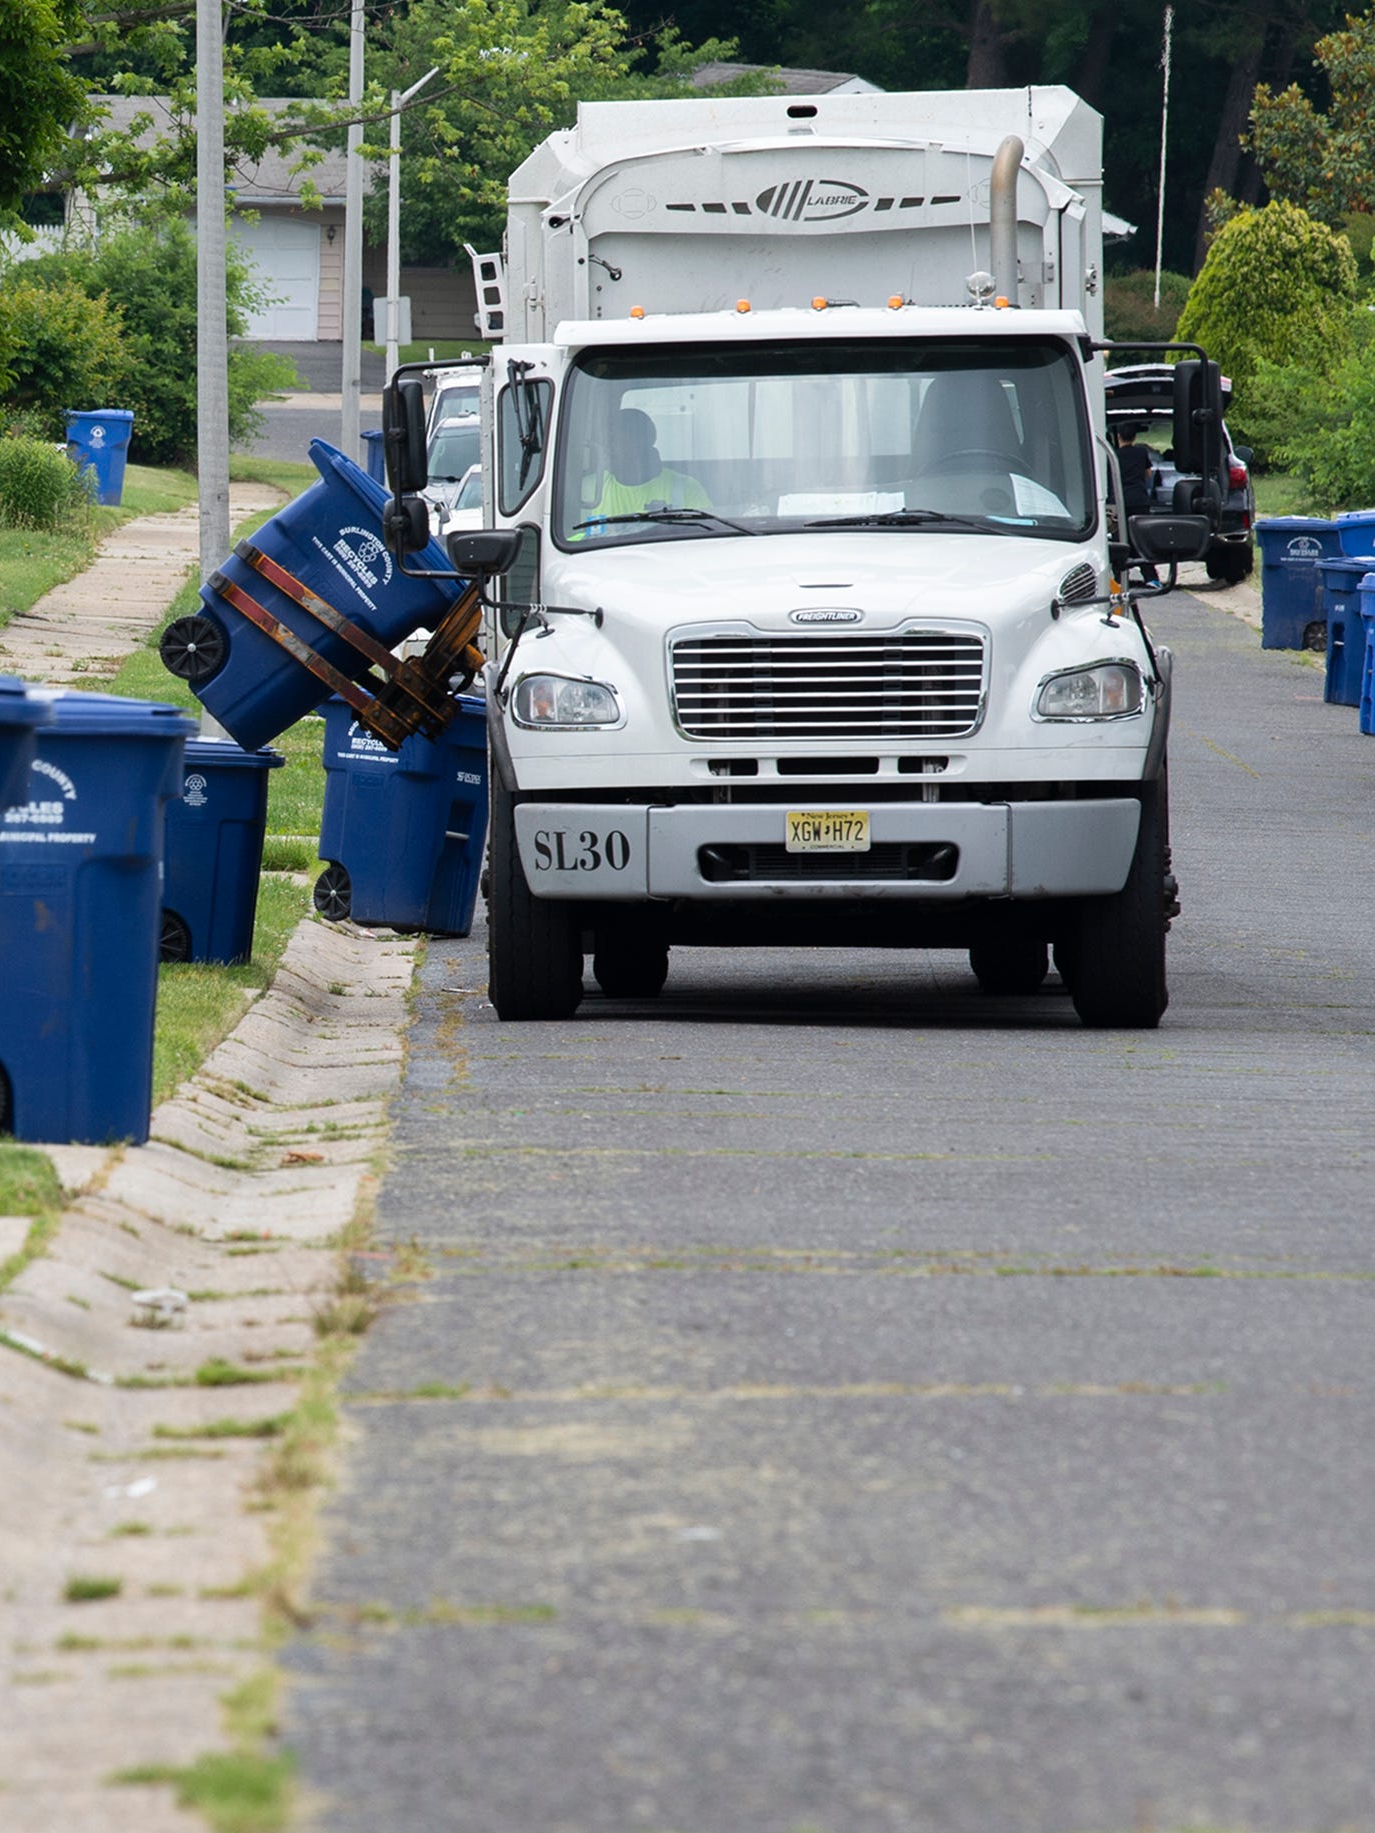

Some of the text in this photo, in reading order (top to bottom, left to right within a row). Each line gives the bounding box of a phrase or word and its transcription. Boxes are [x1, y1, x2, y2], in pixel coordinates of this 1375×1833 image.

[807, 195, 857, 206] LABRIE
[338, 538, 378, 585] RECYCLES
[339, 526, 393, 585] BURLINGTON COUNTY
[355, 587, 377, 611] PROPERTY
[797, 612, 856, 621] FREIGHTLINER
[31, 759, 77, 800] COUNTY
[825, 812, 848, 820] Jersey
[47, 832, 97, 844] PROPERTY
[534, 830, 631, 871] SL30
